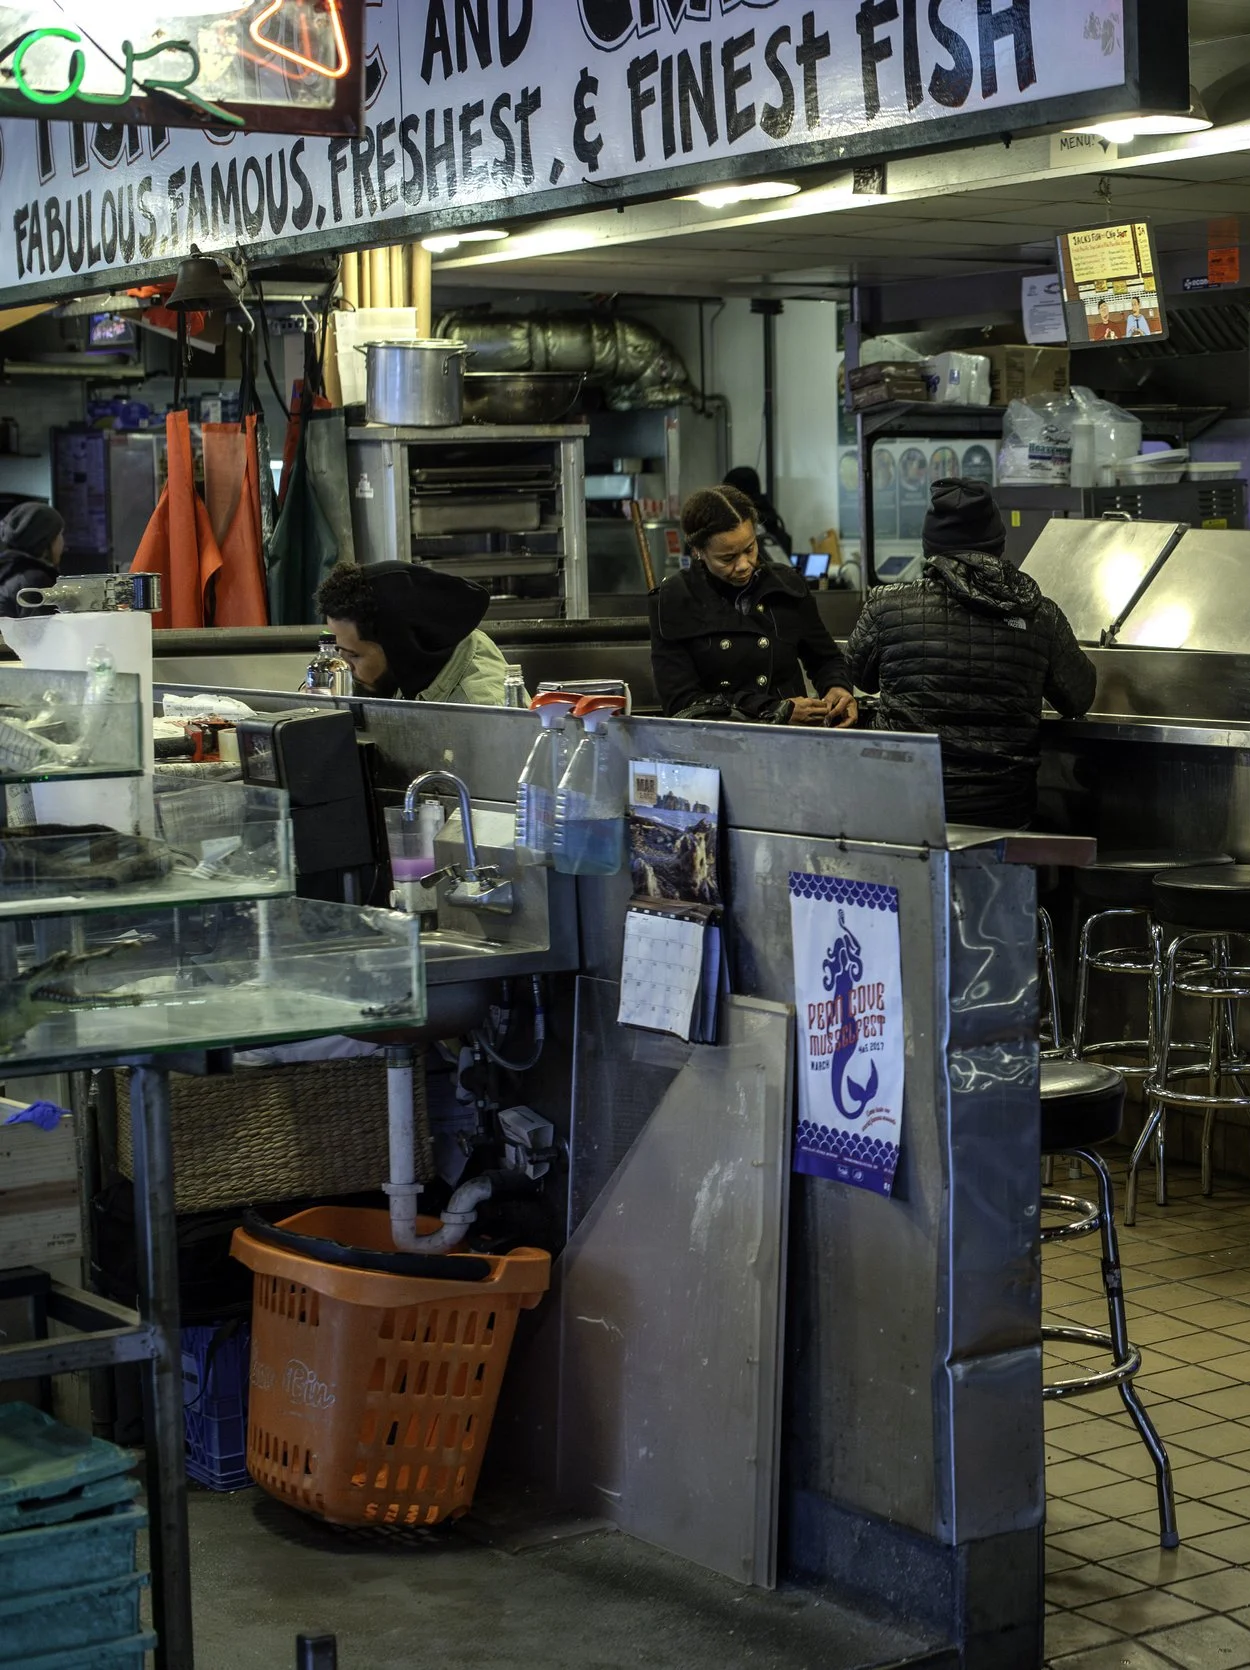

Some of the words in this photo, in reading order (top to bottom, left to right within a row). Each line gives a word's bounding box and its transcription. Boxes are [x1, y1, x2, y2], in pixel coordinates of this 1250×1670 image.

[421, 0, 533, 85] AND
[573, 67, 603, 172] &
[627, 12, 831, 162] FINEST
[856, 0, 1037, 120] FISH
[1060, 135, 1095, 151] MENU!
[848, 981, 886, 1017] COVE
[809, 1014, 886, 1057] MUSSELFEST
[869, 1041, 885, 1052] 2017
[810, 1059, 830, 1071] MARCH
